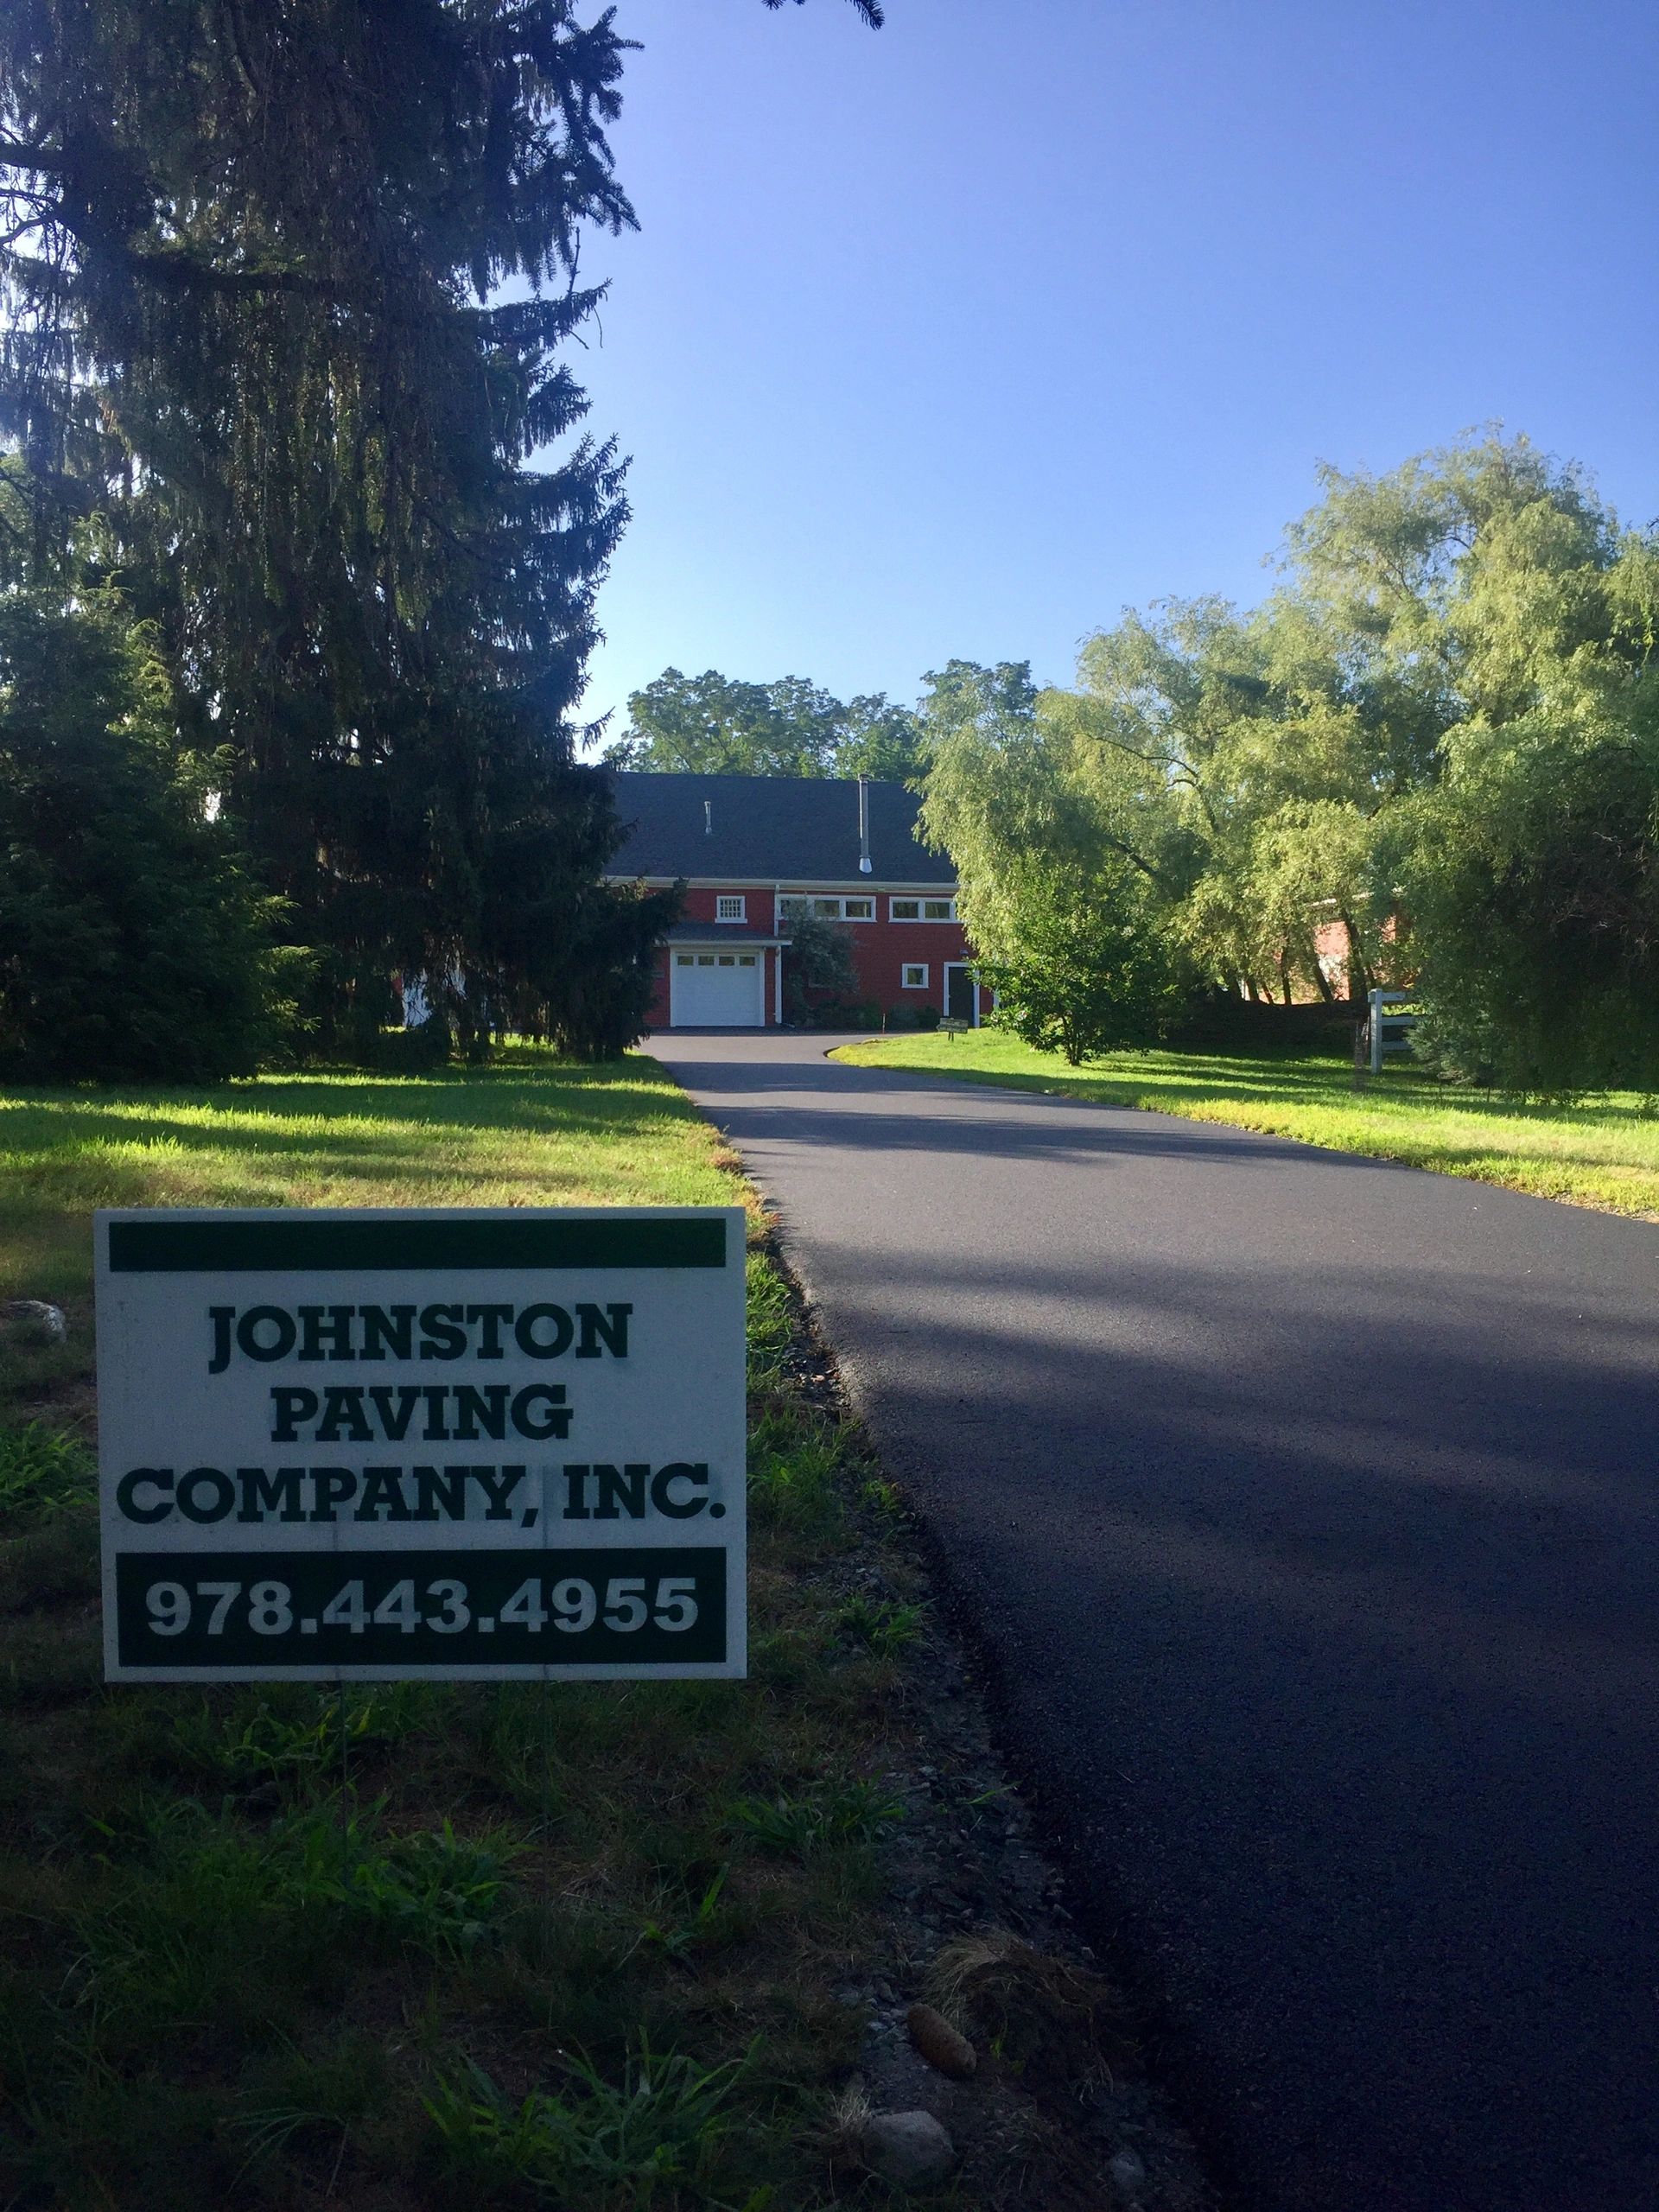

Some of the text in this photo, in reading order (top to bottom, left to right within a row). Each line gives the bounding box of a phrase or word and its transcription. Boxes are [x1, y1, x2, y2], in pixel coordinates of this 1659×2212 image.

[209, 1303, 632, 1374] JOHNSTON
[270, 1384, 573, 1442] PAVING
[116, 1463, 726, 1528] COMPANY, INC.
[145, 1578, 698, 1636] 978.443.4955
